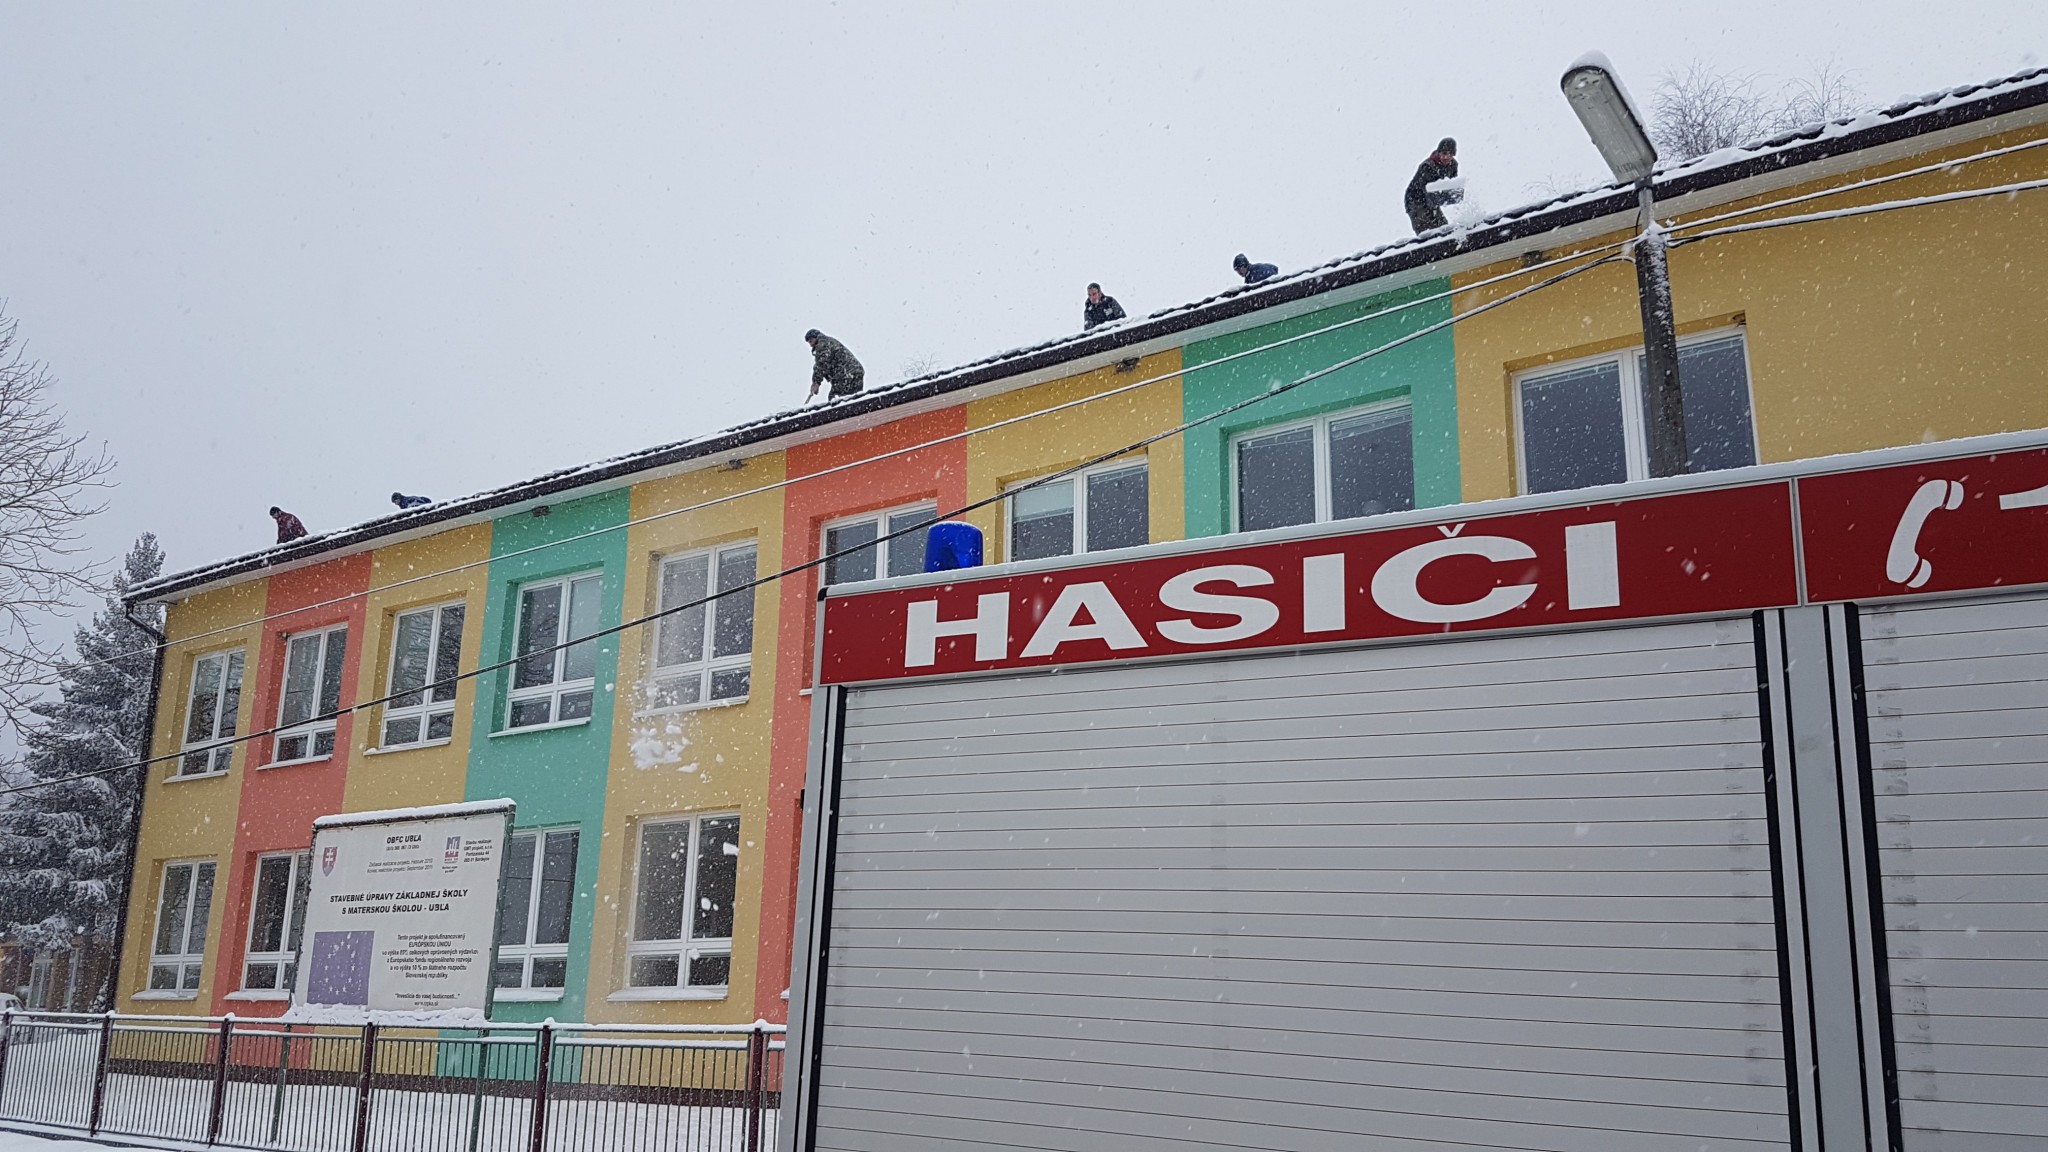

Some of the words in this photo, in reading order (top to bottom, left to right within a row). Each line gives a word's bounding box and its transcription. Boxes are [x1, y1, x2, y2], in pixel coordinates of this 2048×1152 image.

[904, 520, 1621, 668] HASIČI
[330, 892, 365, 902] STAVEBNÉ
[366, 892, 395, 901] ÚPRAVY
[396, 890, 440, 900] ZÁKLADNEJ
[442, 888, 468, 898] ŠKOLY
[348, 906, 390, 914] MATERSKOU
[392, 904, 422, 912] ŠKOLOU
